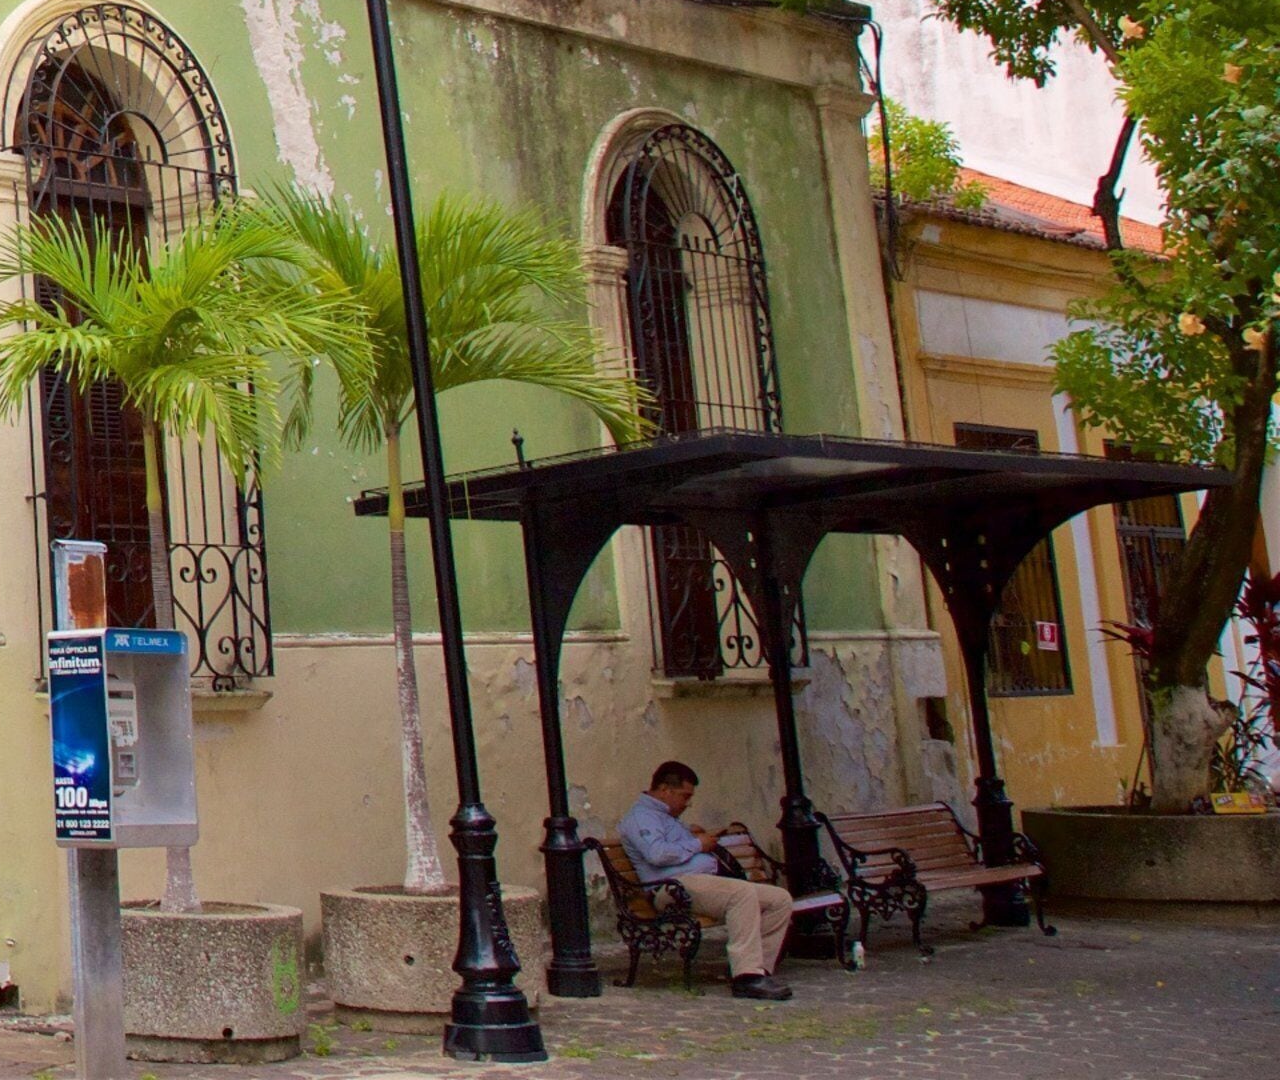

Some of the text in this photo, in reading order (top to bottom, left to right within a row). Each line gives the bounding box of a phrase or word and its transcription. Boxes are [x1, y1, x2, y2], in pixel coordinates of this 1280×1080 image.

[132, 636, 168, 646] TELMEX
[56, 786, 87, 808] 100
[92, 819, 109, 828] 2222
